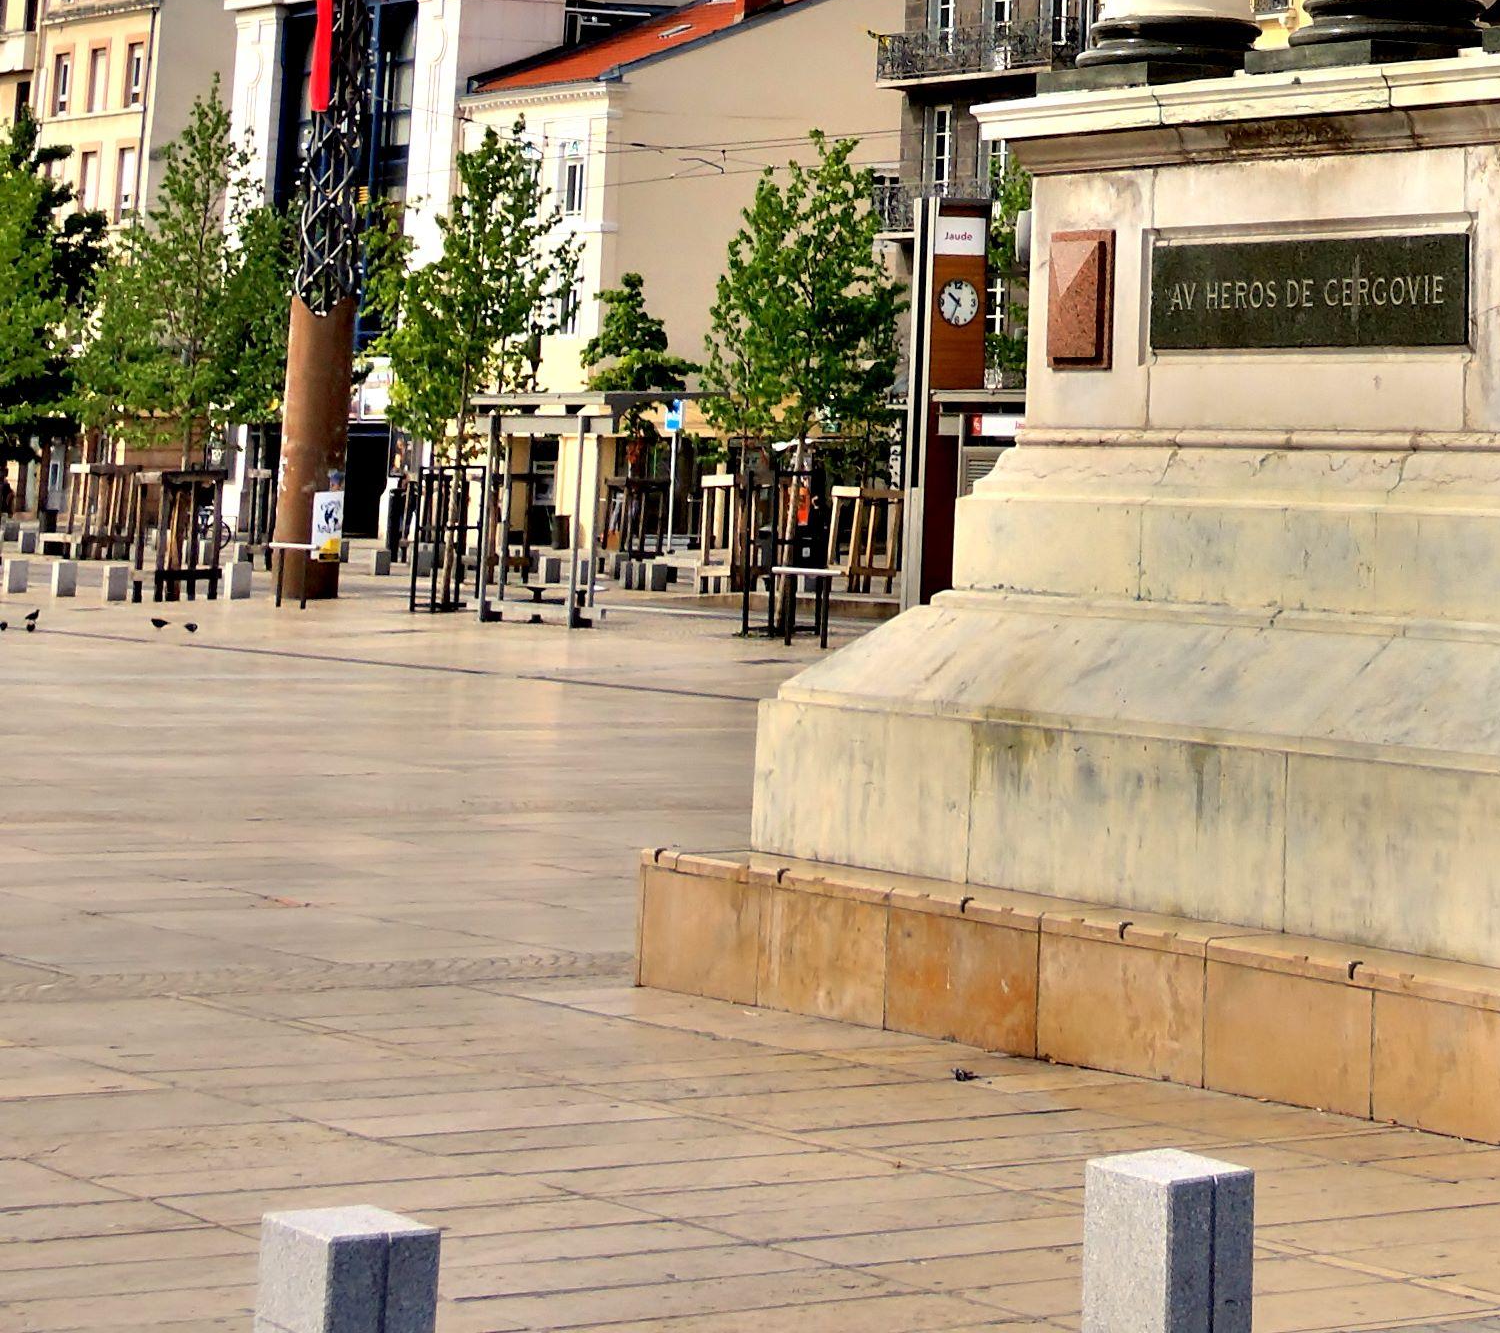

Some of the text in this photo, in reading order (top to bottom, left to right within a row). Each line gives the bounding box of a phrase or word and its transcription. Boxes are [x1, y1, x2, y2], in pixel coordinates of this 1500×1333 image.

[945, 232, 972, 241] Jaude
[1170, 276, 1446, 311] AV HEROS DE GERGOVIE
